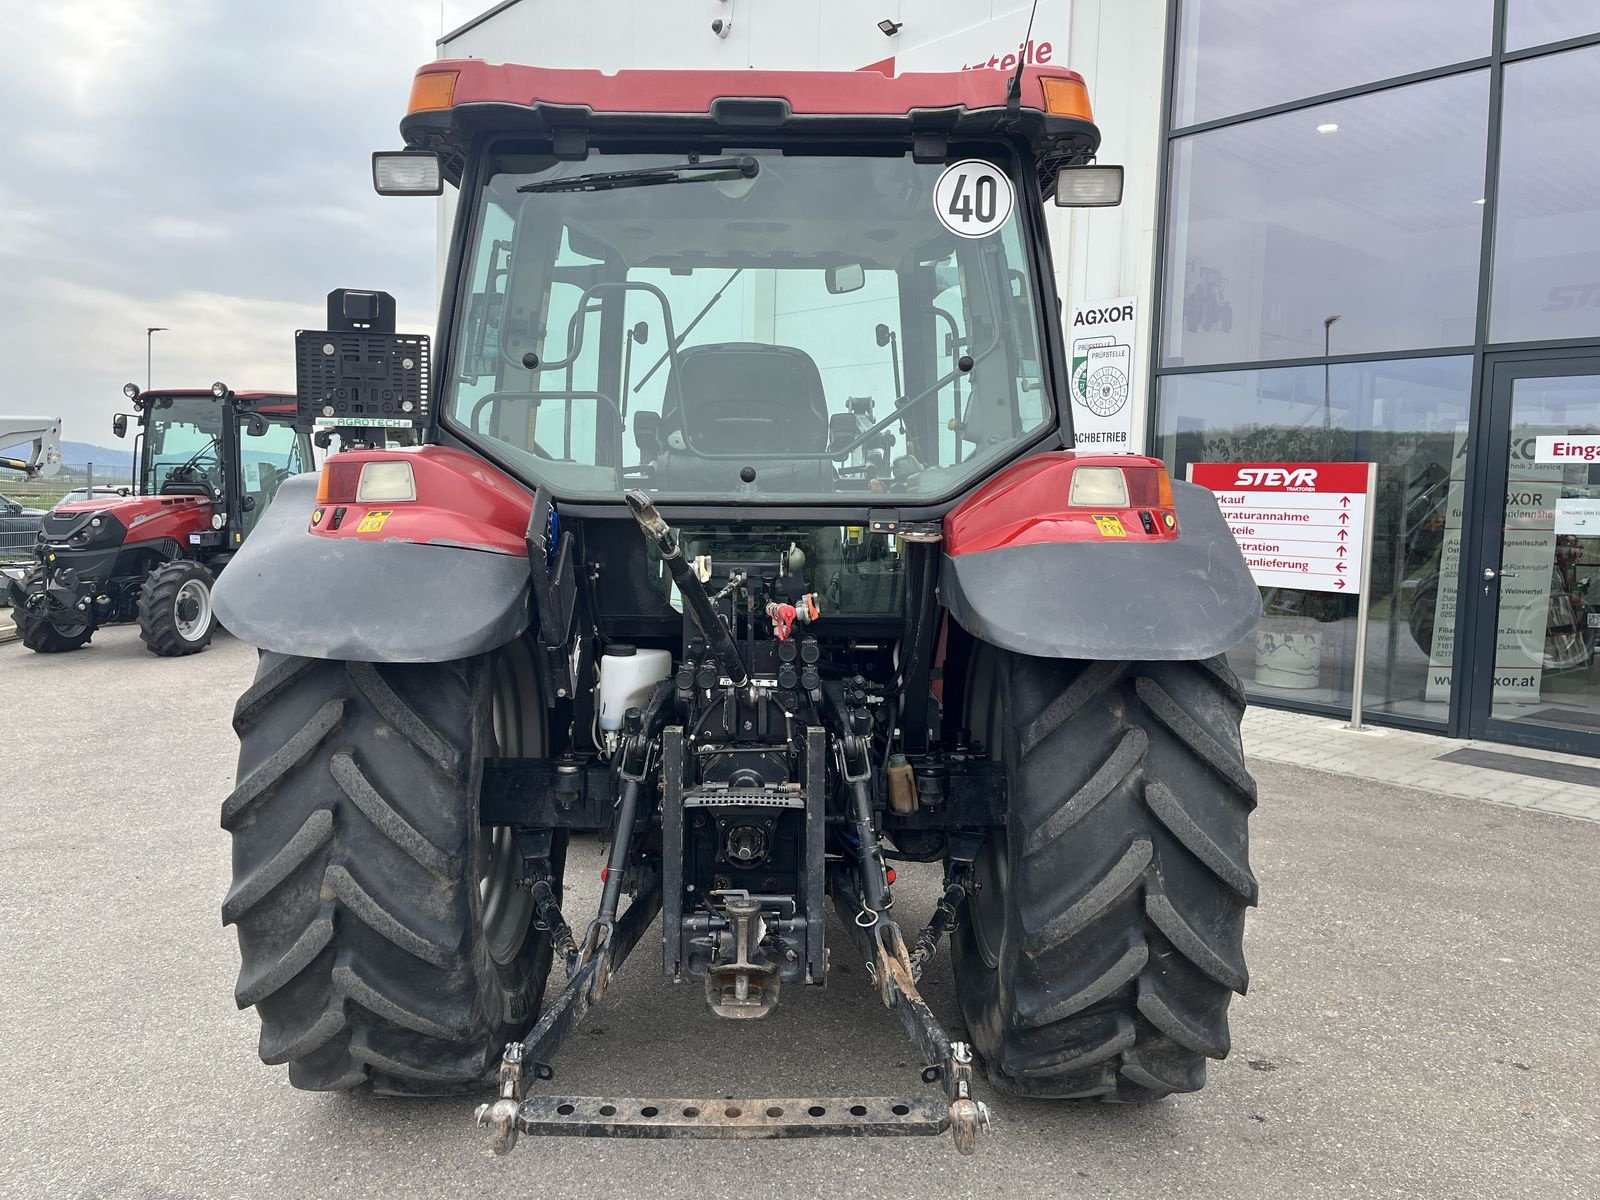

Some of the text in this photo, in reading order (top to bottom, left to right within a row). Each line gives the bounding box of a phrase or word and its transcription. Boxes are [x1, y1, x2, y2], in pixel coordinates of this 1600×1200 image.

[949, 174, 997, 223] 40
[1073, 305, 1134, 327] AGXOR
[1091, 349, 1126, 359] PRÜFSTELLE
[338, 419, 401, 428] AGROTECH
[1534, 463, 1561, 471] Service
[1234, 468, 1318, 487] STEYR
[1231, 526, 1255, 536] teile
